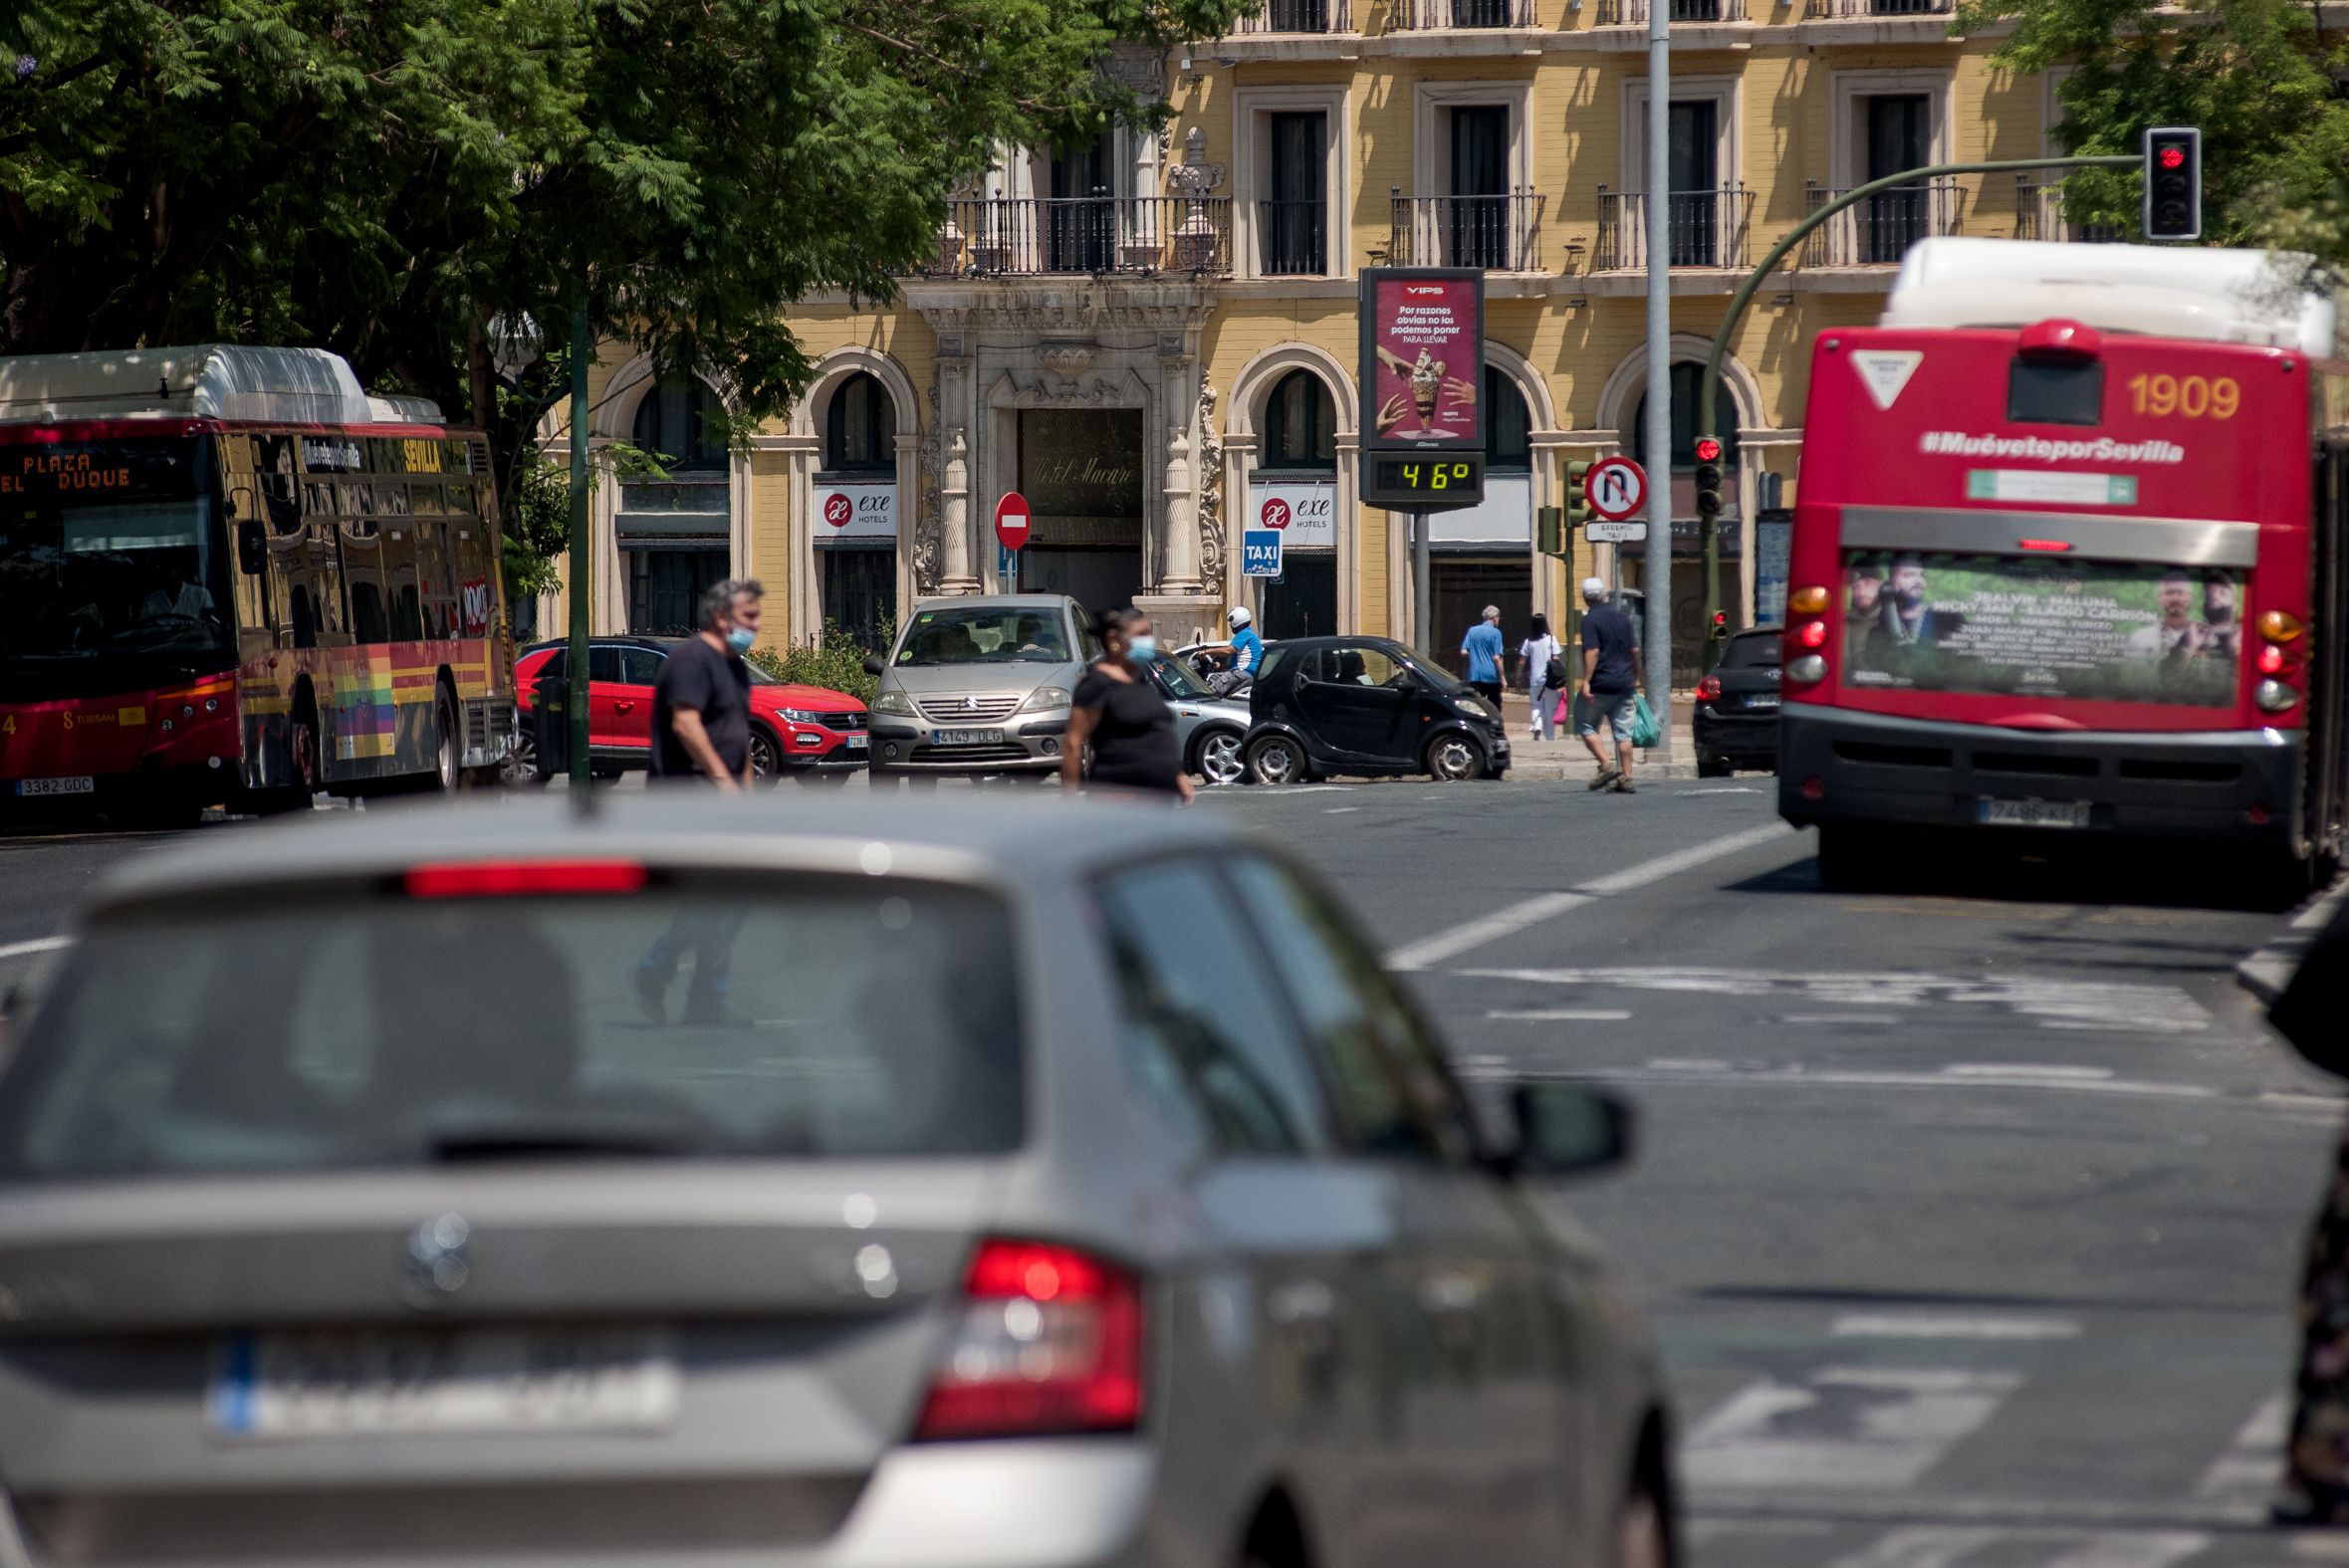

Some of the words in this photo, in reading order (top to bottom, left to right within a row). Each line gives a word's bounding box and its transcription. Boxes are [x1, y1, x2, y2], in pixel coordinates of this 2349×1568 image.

[1399, 306, 1415, 315] Por
[1397, 316, 1427, 325] obvias
[1441, 316, 1454, 325] los
[1391, 326, 1432, 335] podemos
[1433, 327, 1461, 336] poner
[2128, 373, 2240, 420] 1909
[403, 439, 441, 474] SEVILLA
[1920, 431, 2185, 464] #MuéveteporSevilla
[23, 454, 90, 474] PLAZA
[1, 475, 24, 493] EL
[59, 468, 129, 489] DUQUE
[858, 495, 890, 512] exe
[1296, 499, 1330, 517] exe
[1246, 546, 1278, 560] TAXI
[2, 715, 16, 735] 4
[77, 714, 116, 724] TUSSAM
[24, 780, 60, 793] 3382
[64, 778, 91, 791] GDC
